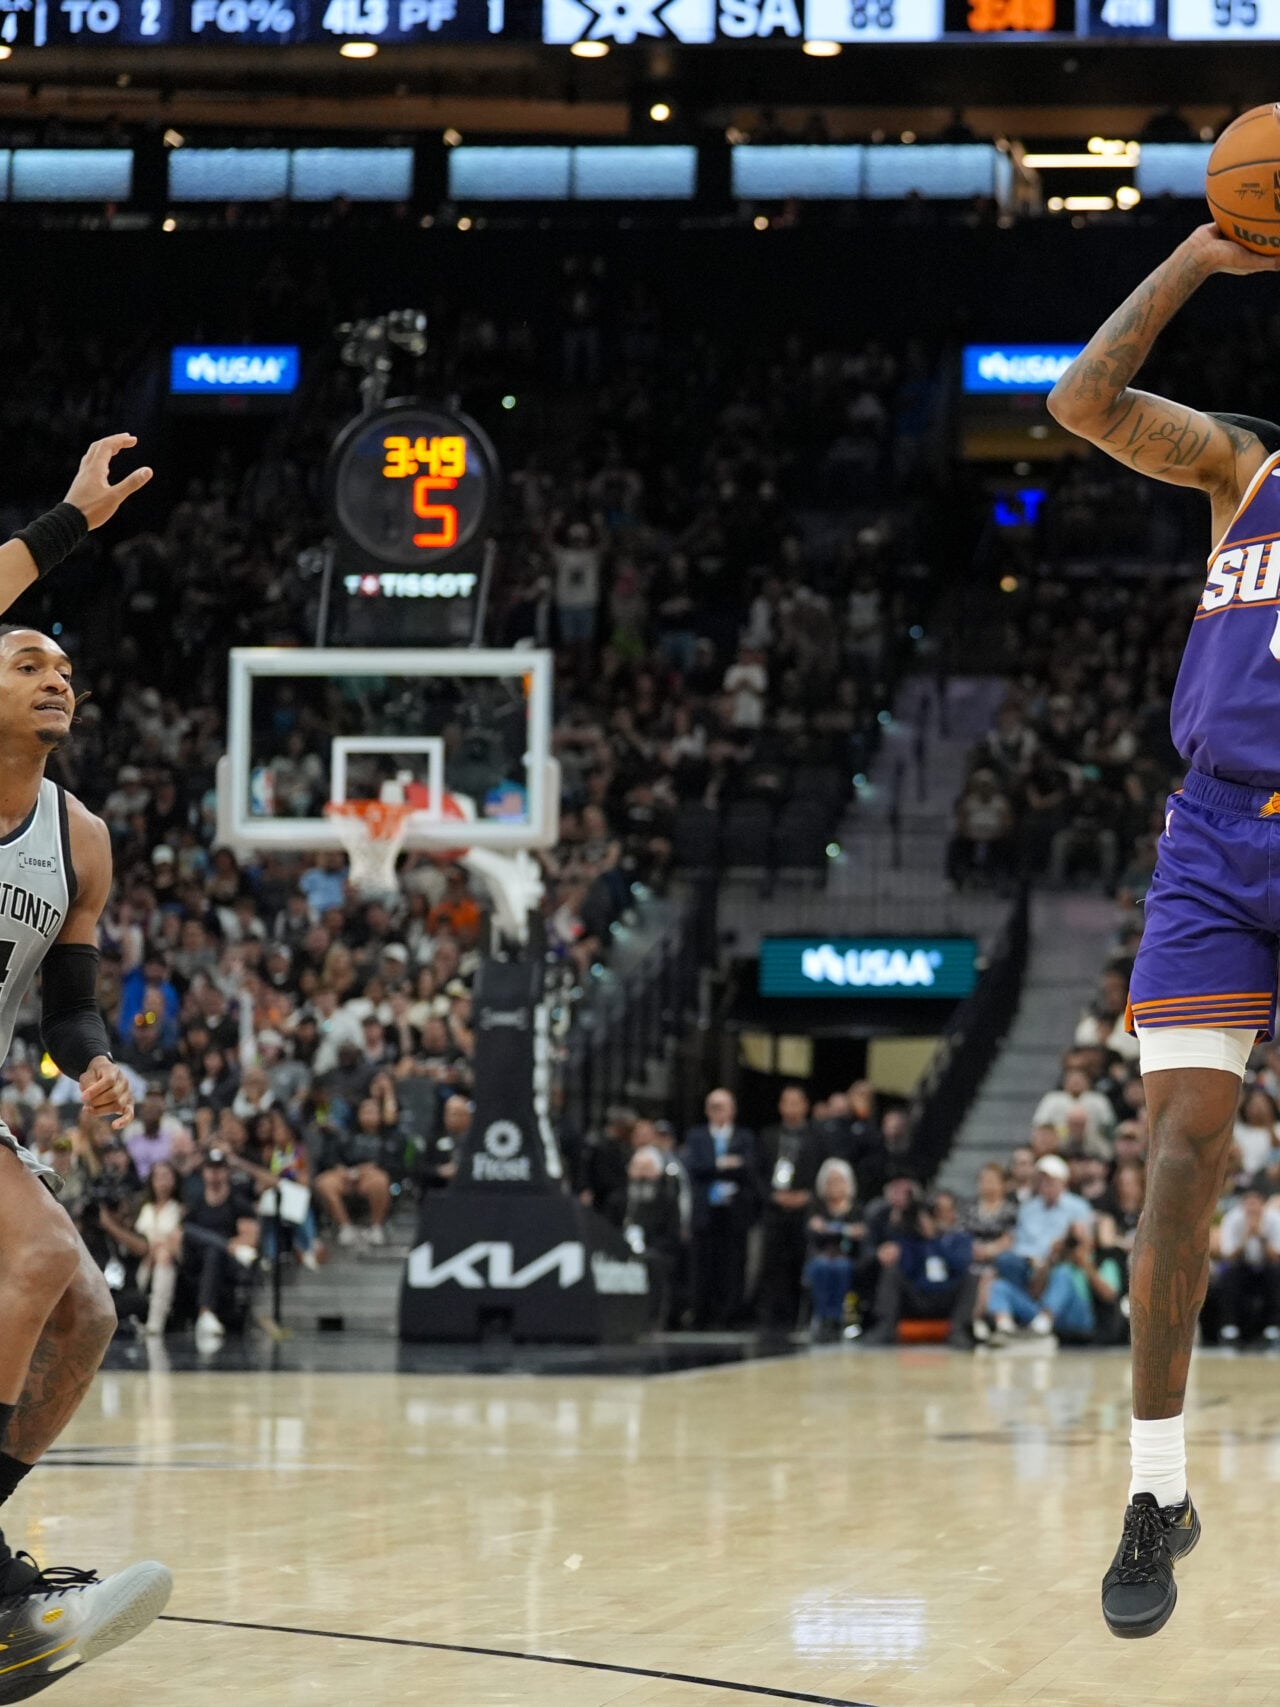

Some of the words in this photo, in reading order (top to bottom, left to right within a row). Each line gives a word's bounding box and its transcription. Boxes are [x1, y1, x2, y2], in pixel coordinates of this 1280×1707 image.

[61, 0, 120, 33] TO
[191, 0, 295, 33] FG%
[399, 0, 456, 31] PF
[719, 0, 801, 37] SA
[382, 436, 467, 478] 3:49
[412, 475, 458, 548] 5
[378, 573, 477, 598] TISSOT
[23, 856, 52, 869] LEDGER
[0, 882, 61, 938] TONIO
[845, 948, 936, 987] USAA
